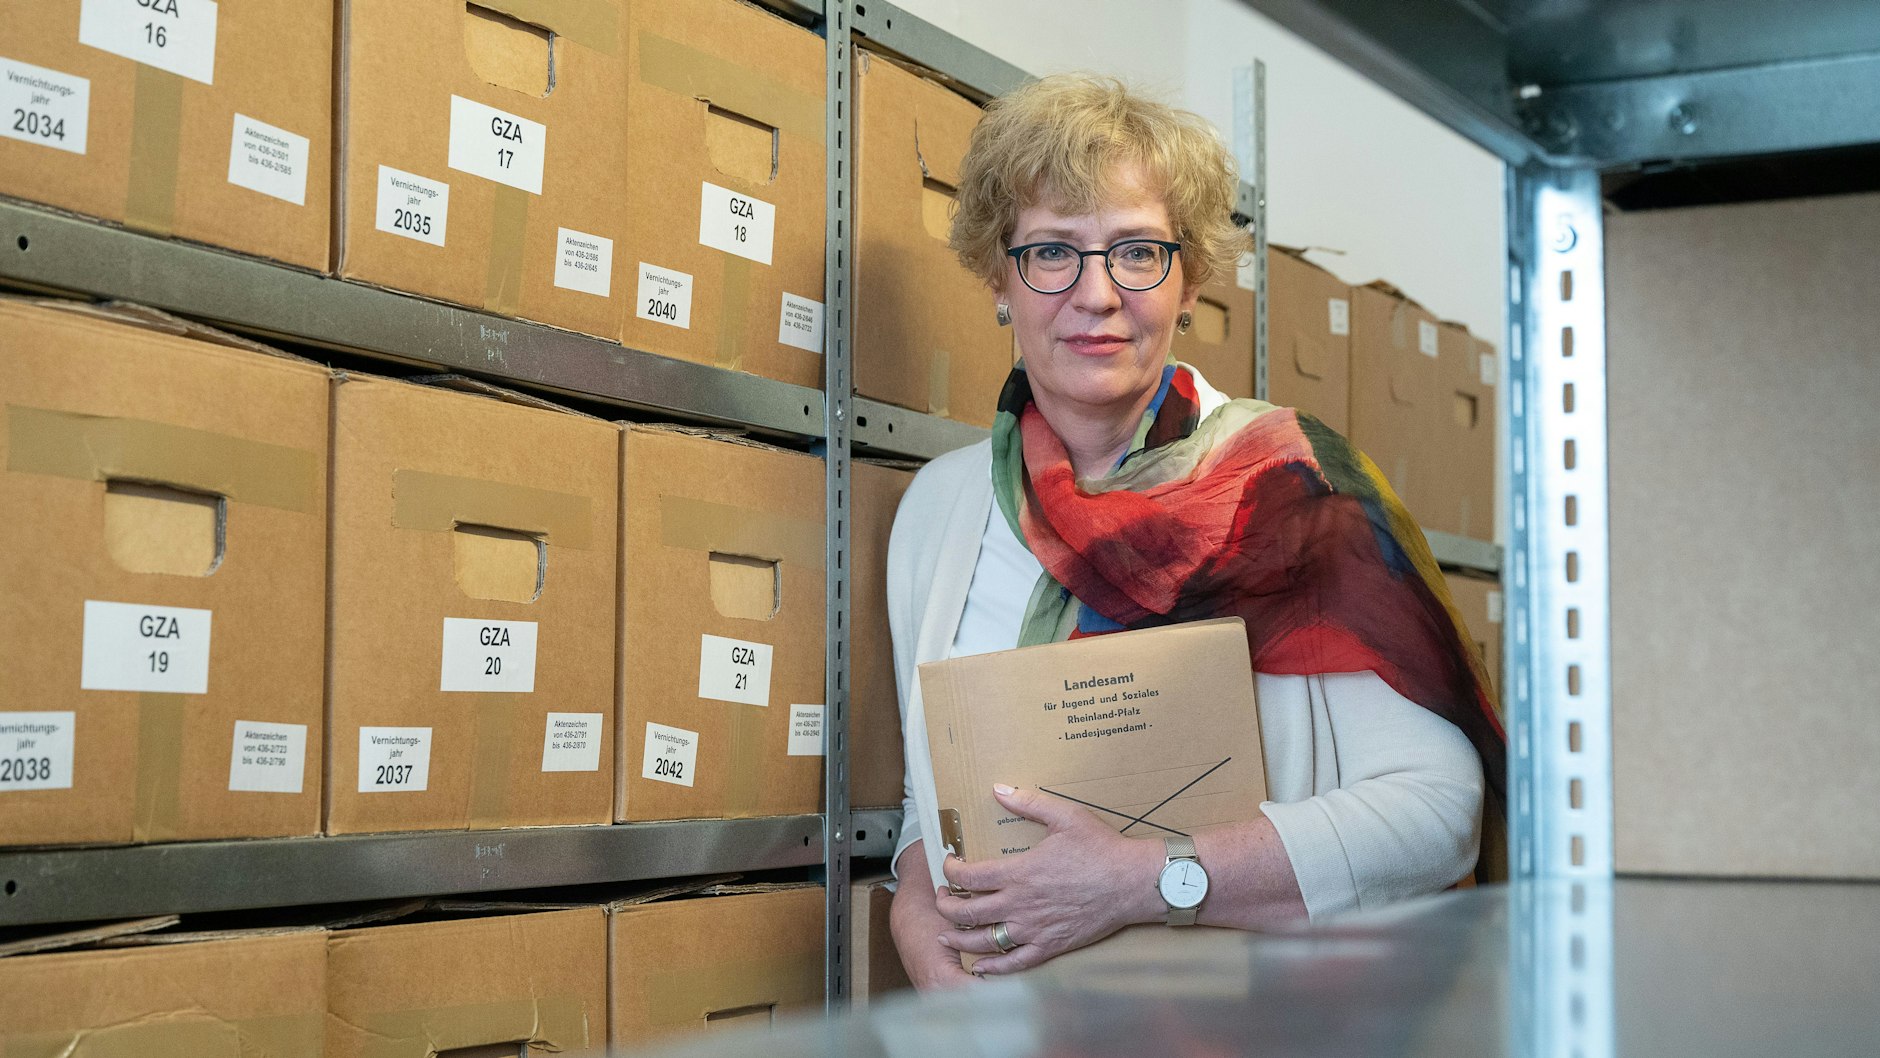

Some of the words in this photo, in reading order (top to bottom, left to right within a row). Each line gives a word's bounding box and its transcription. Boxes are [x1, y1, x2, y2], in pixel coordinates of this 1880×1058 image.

[145, 22, 166, 47] 16
[7, 69, 76, 97] Vernichtungs-
[31, 91, 50, 105] jahr
[13, 108, 65, 141] 2034
[491, 116, 523, 144] GZA
[244, 127, 289, 149] Aktenzeichen
[244, 141, 257, 151] von
[248, 153, 259, 165] bis
[498, 148, 514, 169] 17
[390, 176, 439, 199] Vernichtungs-
[407, 195, 421, 206] jahr
[729, 197, 754, 220] GZA
[394, 208, 431, 235] 2035
[734, 224, 747, 243] 18
[565, 249, 574, 257] von
[566, 237, 598, 251] Aktenzeichen
[564, 258, 572, 267] bis
[645, 271, 683, 289] Vernichtungs-
[658, 286, 669, 296] jahr
[647, 298, 677, 321] 2040
[139, 615, 180, 640] GZA
[479, 627, 511, 647] GZA
[148, 651, 169, 674] 19
[485, 656, 502, 675] 20
[731, 646, 755, 666] GZA
[735, 672, 747, 690] 21
[1064, 672, 1135, 691] Landesamt
[1044, 701, 1057, 711] für
[1061, 696, 1096, 710] Jugend
[1100, 693, 1118, 704] und
[1122, 688, 1160, 701] Soziales
[554, 720, 588, 728] Aktenzeichen
[1067, 706, 1141, 724] Rheinland-Pfalz
[654, 731, 690, 747] Vernichtungs-
[1065, 722, 1147, 741] Landesjugendamt
[16, 737, 36, 752] jahr
[243, 744, 256, 752] von
[371, 736, 421, 747] Vernichtungs-
[552, 741, 560, 749] bis
[665, 744, 677, 755] jahr
[242, 755, 252, 765] bis
[389, 748, 403, 760] jahr
[0, 757, 51, 782] 2038
[375, 765, 413, 785] 2037
[654, 757, 684, 779] 2042
[997, 816, 1026, 826] geboren
